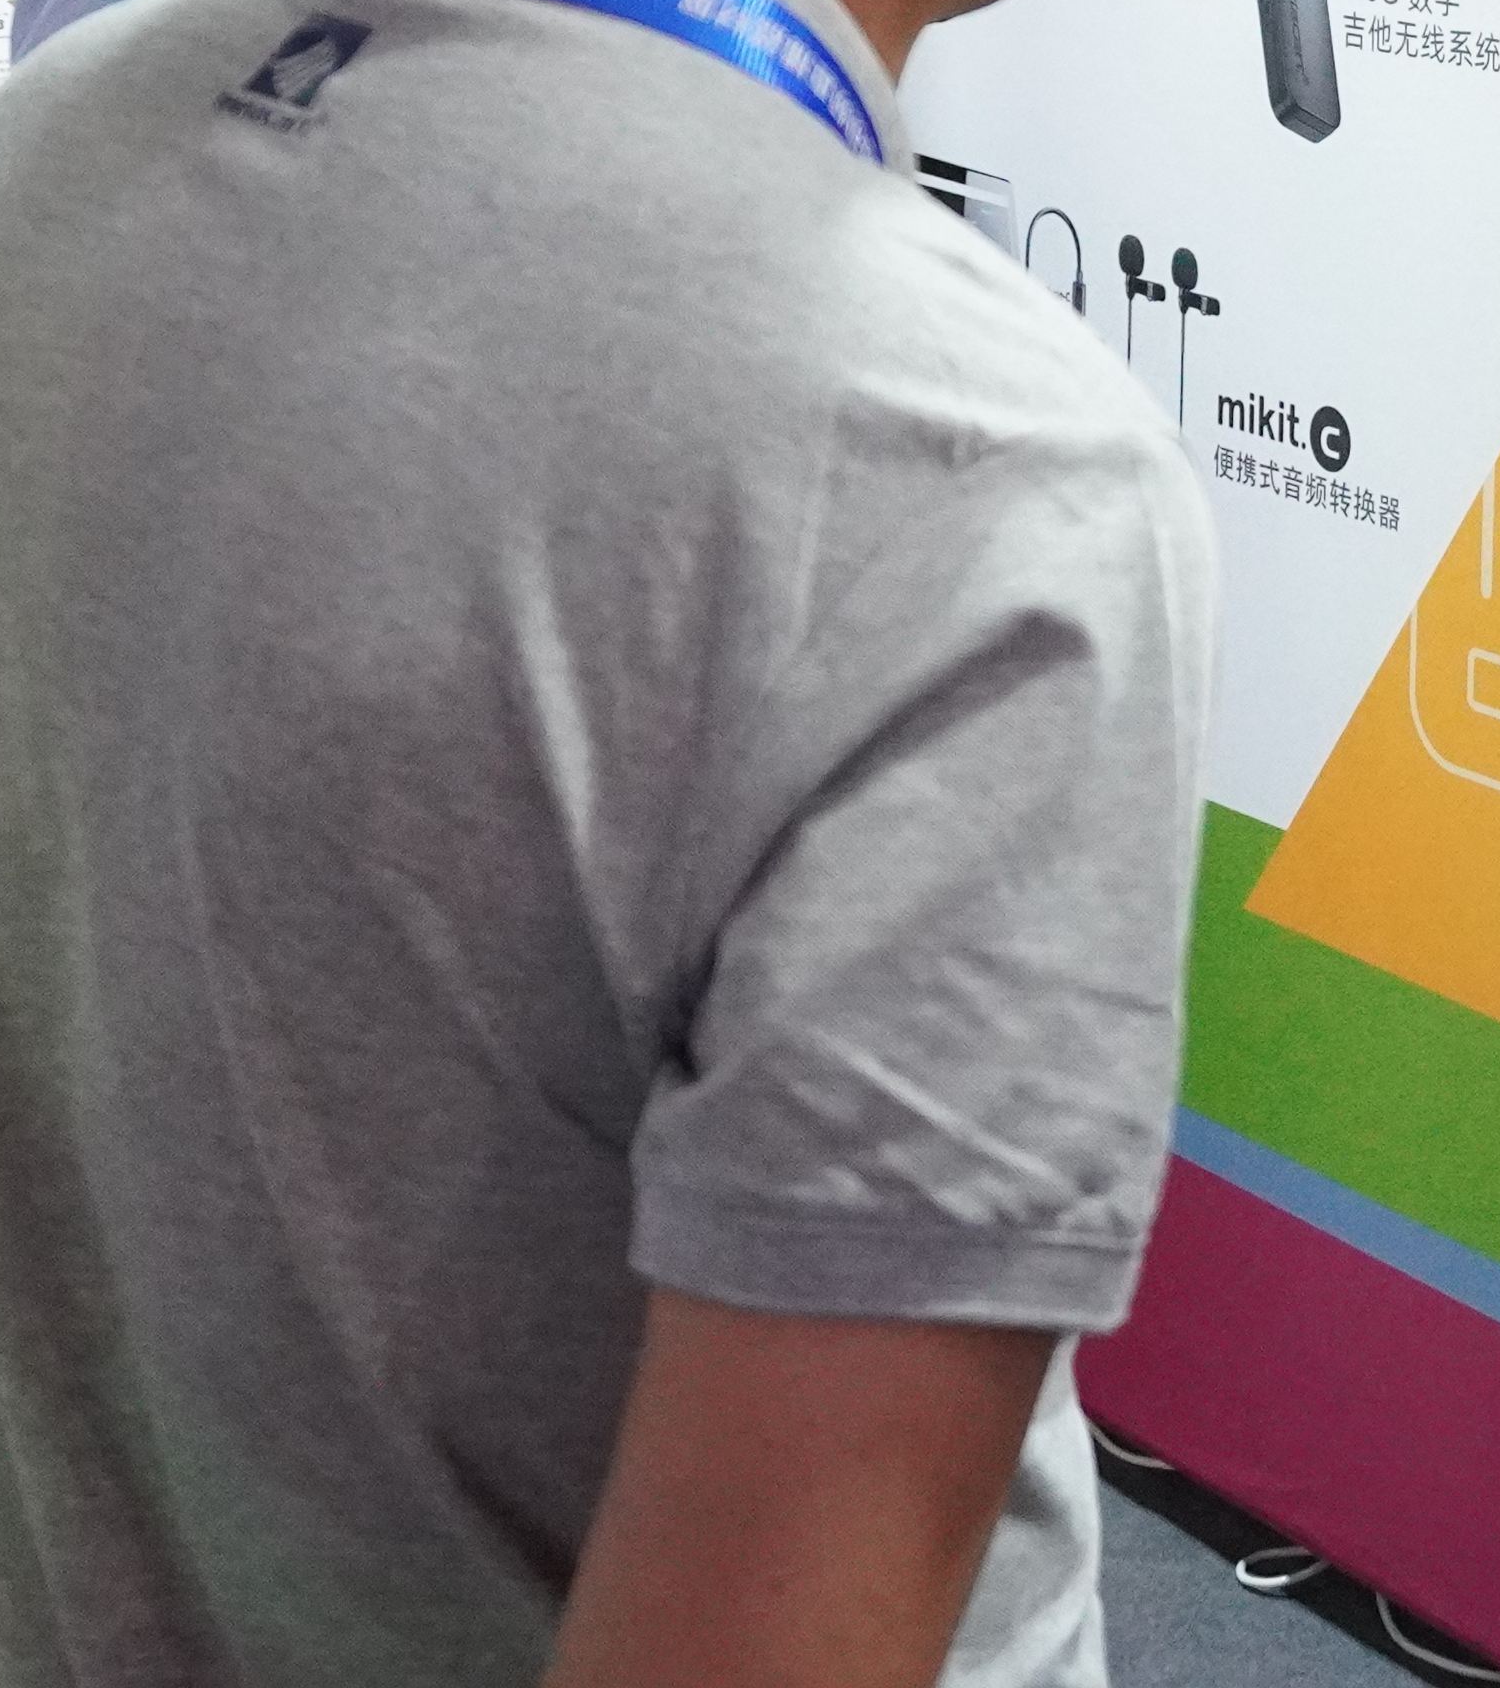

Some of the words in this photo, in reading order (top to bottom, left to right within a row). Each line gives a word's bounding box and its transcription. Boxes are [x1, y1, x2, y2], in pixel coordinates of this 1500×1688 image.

[1342, 11, 1500, 73] 吉他无线系统
[1213, 444, 1401, 532] 便携式音频转换器
